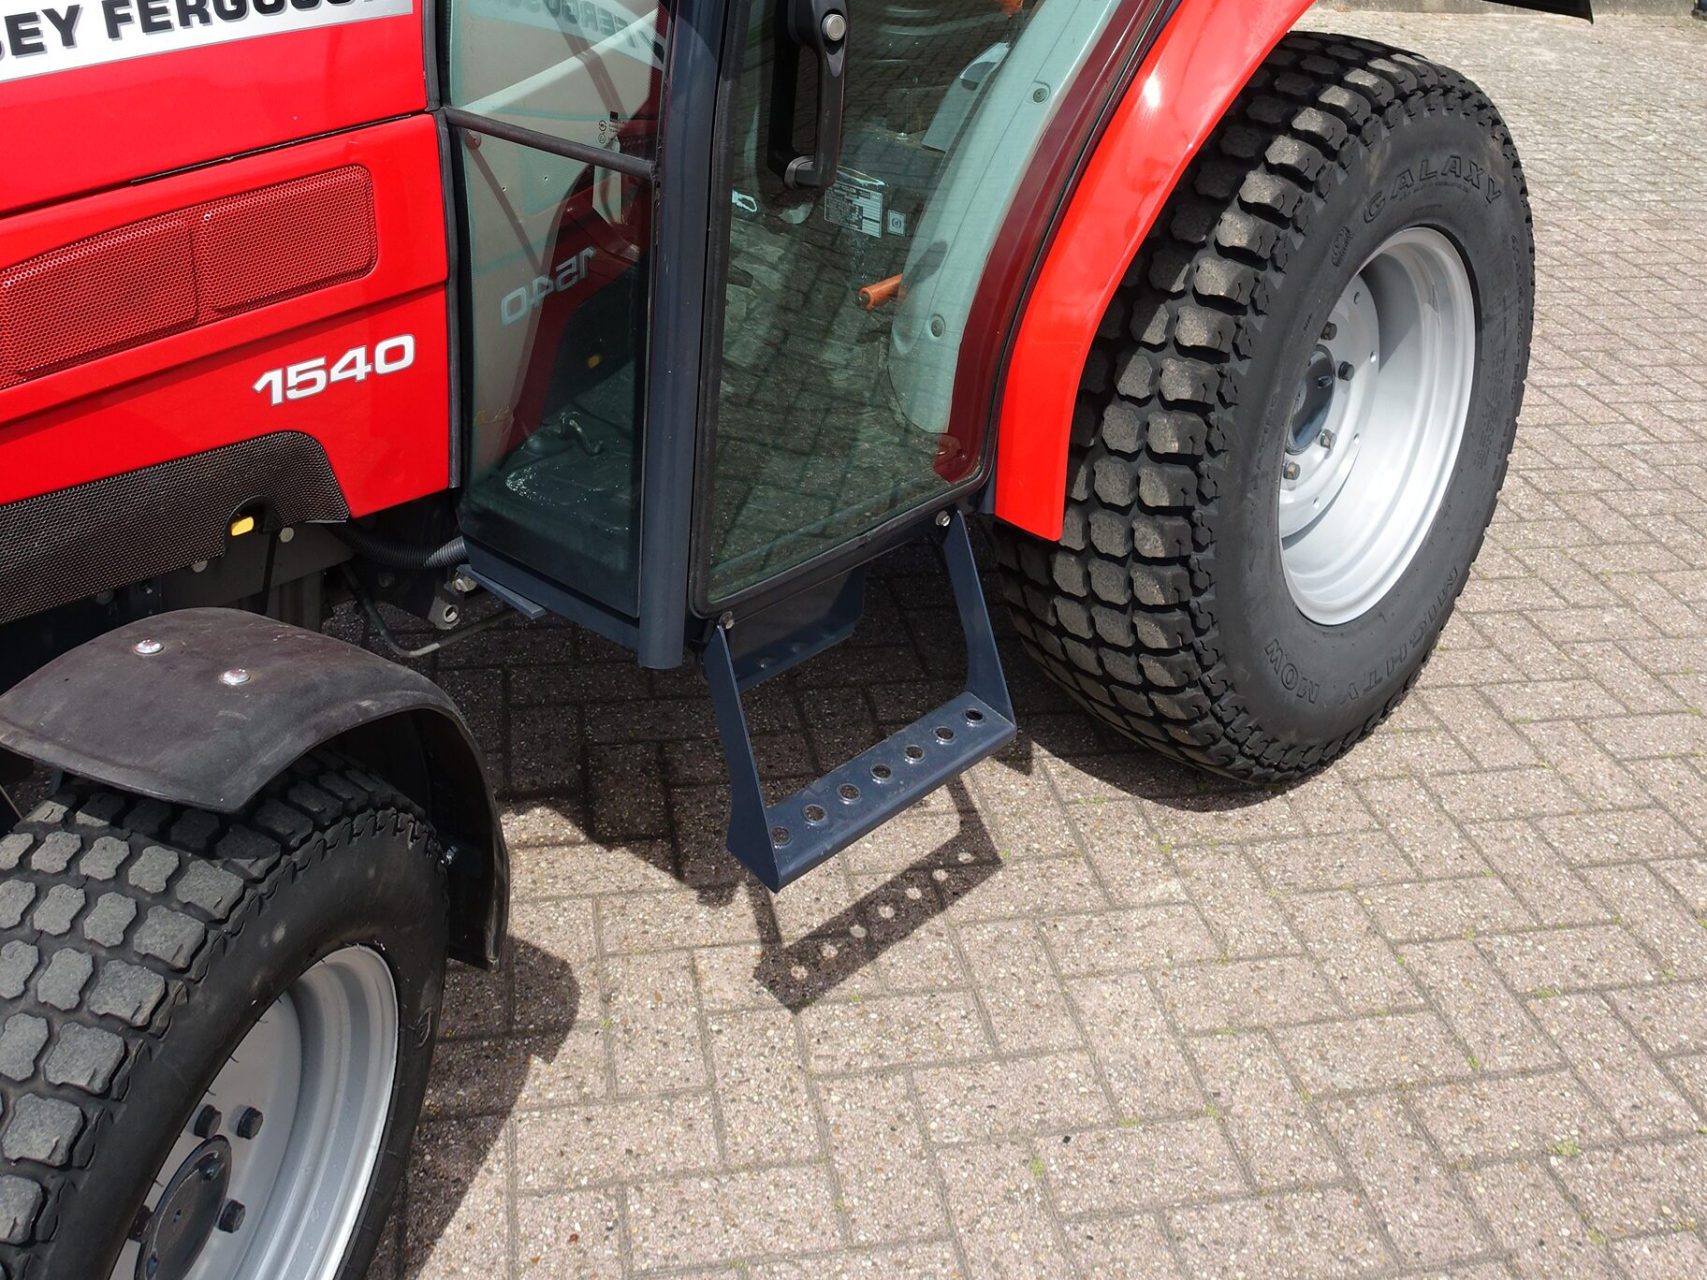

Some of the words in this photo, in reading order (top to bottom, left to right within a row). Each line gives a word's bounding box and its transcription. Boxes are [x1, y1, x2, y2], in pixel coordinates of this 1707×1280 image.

[0, 3, 83, 61] EY
[1363, 155, 1502, 224] GALAXY
[252, 333, 416, 407] 1540
[1264, 638, 1321, 705] MOW
